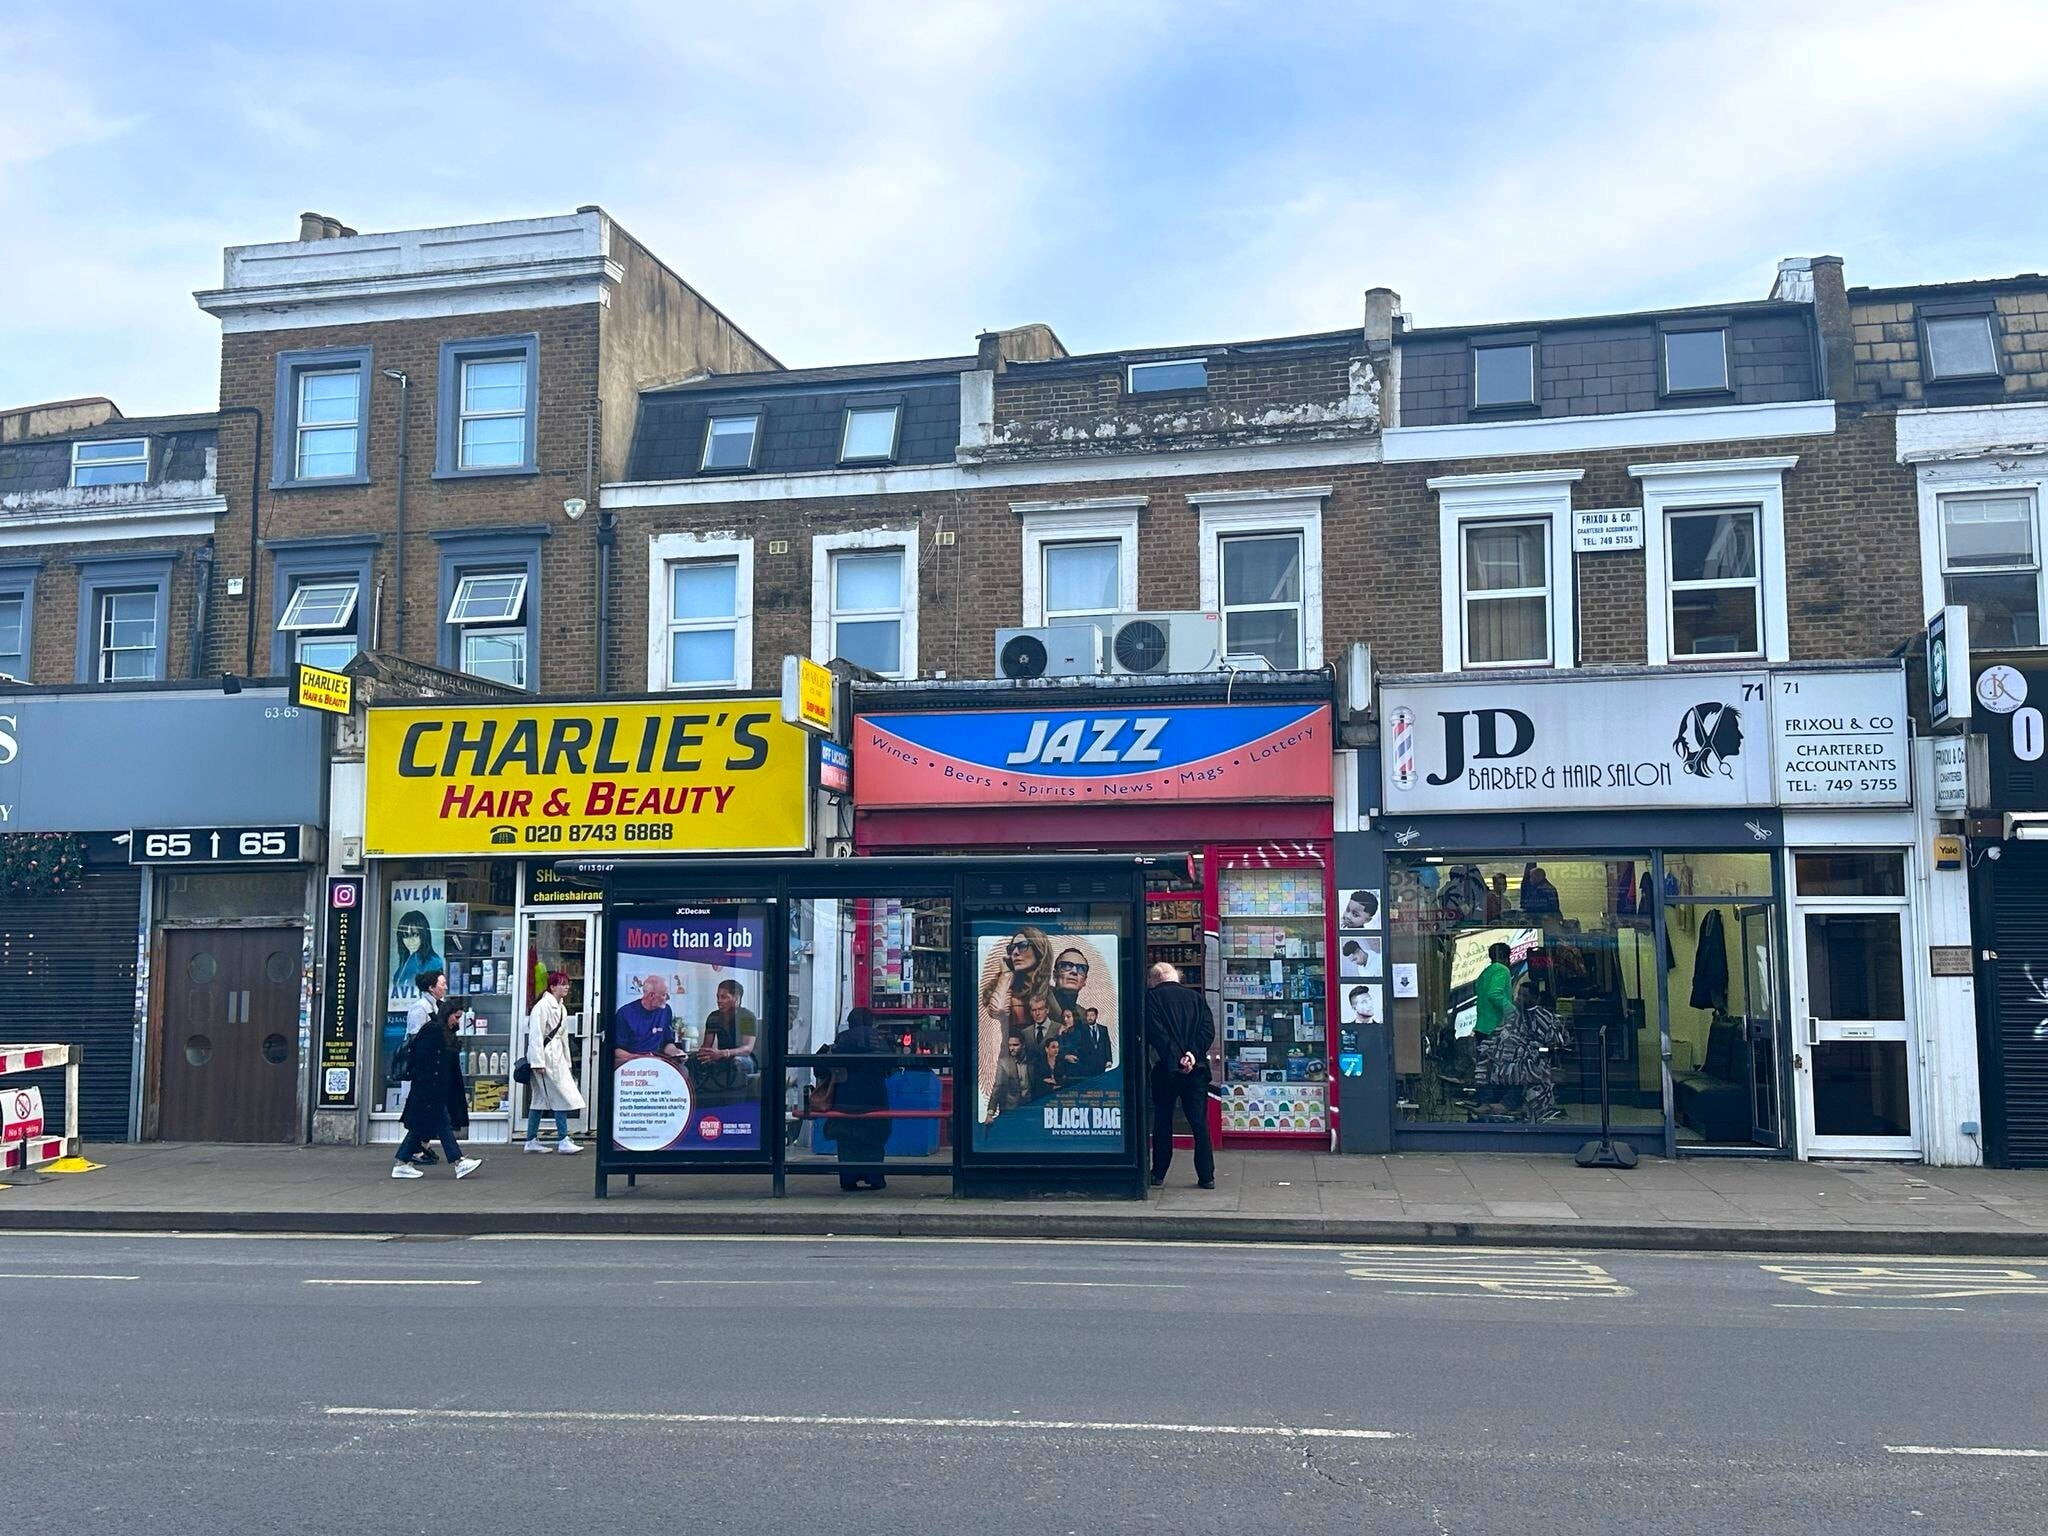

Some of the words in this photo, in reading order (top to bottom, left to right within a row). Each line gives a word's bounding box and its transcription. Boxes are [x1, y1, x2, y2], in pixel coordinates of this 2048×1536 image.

[1582, 514, 1608, 524] FRIXOU
[1612, 514, 1617, 523] &
[1600, 537, 1612, 545] 749
[1616, 536, 1633, 544] 5755
[302, 671, 348, 695] CHARLIE'S
[1783, 682, 1799, 694] 71
[1741, 683, 1764, 702] 71
[264, 707, 299, 719] 63-65
[1785, 718, 1843, 731] FRIXOU
[1850, 718, 1862, 729] &
[1869, 717, 1893, 729] CO
[398, 711, 773, 779] CHARLIE'S
[1005, 717, 1172, 765] JAZZ
[1426, 708, 1535, 786] JD
[1797, 744, 1884, 756] CHARTERED
[871, 734, 919, 766] Wines
[943, 765, 992, 788] Beers
[1018, 781, 1076, 797] Spirits
[1103, 781, 1153, 796] News
[1180, 765, 1224, 785] Mags
[1249, 726, 1314, 763] Lottery
[1785, 759, 1896, 772] ACCOUNTANTS
[1468, 765, 1537, 791] BARBER
[1541, 765, 1556, 789] &
[1563, 764, 1602, 789] HAIR
[1607, 762, 1672, 788] SALON
[1786, 780, 1817, 792] TEL:
[1825, 779, 1853, 791] 749
[1861, 779, 1897, 790] 5755
[542, 786, 571, 817] &
[525, 824, 561, 843] 020
[568, 824, 617, 842] 8743
[623, 822, 674, 841] 6868
[146, 834, 191, 857] 65
[239, 831, 286, 855] 65
[1940, 846, 1958, 855] Yale
[1025, 906, 1061, 914] JCDecaux
[627, 928, 669, 949] More
[672, 927, 709, 948] than
[713, 932, 723, 948] a
[725, 927, 752, 952] job
[637, 1069, 659, 1077] starting
[700, 1121, 720, 1129] CENTRE
[1043, 1107, 1090, 1129] BLACK
[1092, 1107, 1121, 1129] BAG
[8, 1127, 17, 1136] No
